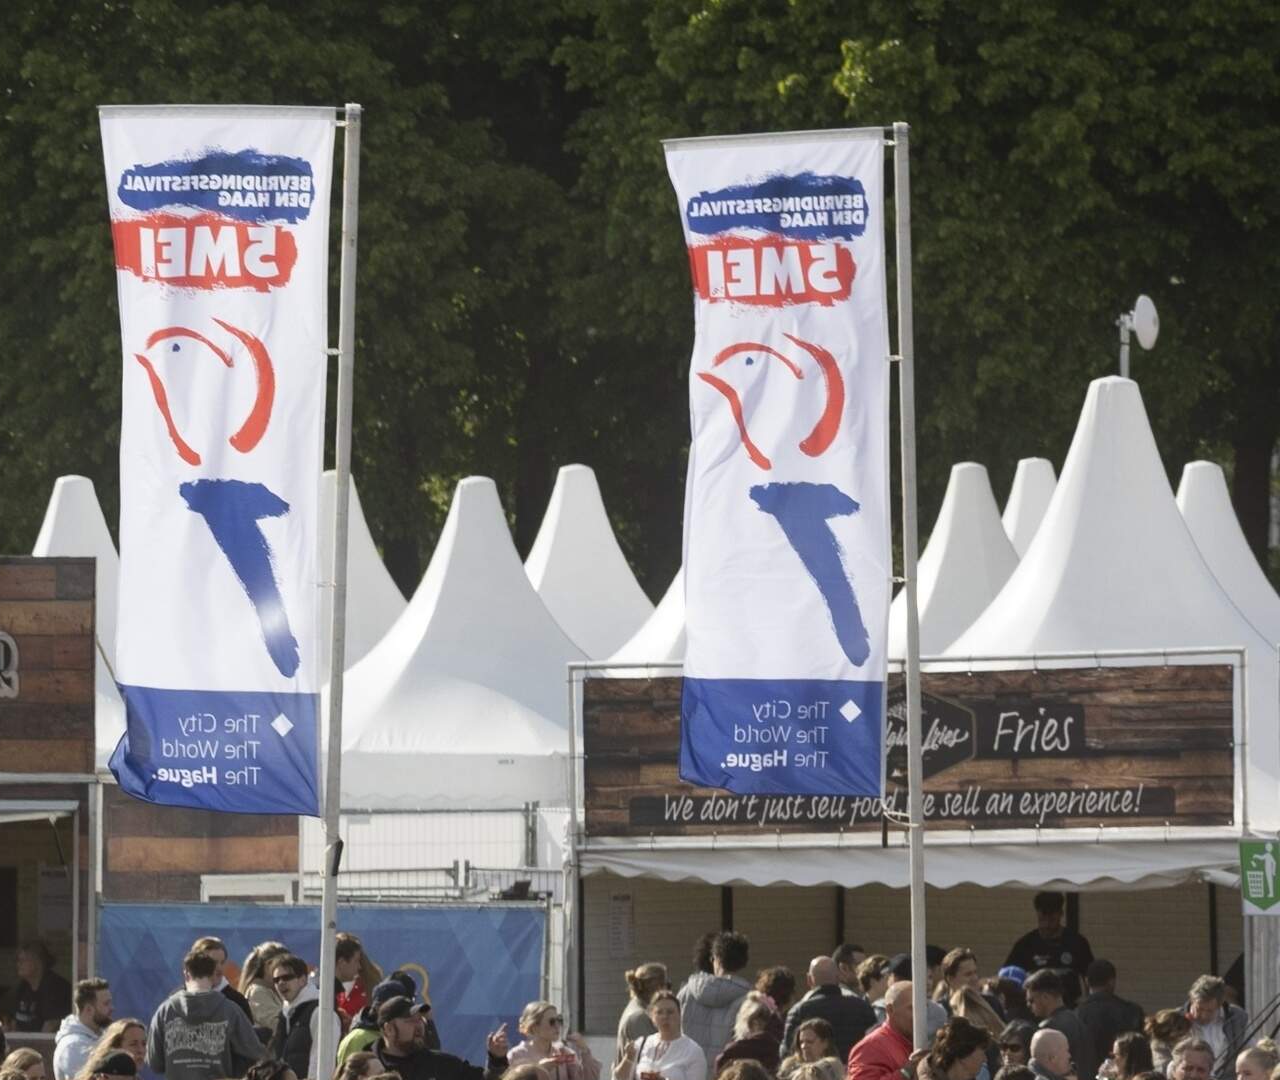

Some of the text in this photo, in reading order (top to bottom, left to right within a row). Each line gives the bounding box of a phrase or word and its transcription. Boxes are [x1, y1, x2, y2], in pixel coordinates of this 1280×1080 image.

[994, 707, 1074, 752] Fries
[664, 793, 694, 820] We
[700, 791, 756, 820] don't
[758, 795, 805, 827] just
[808, 795, 846, 818] sell
[940, 786, 980, 816] sell
[986, 792, 1013, 815] an
[1019, 783, 1143, 824] experience!
